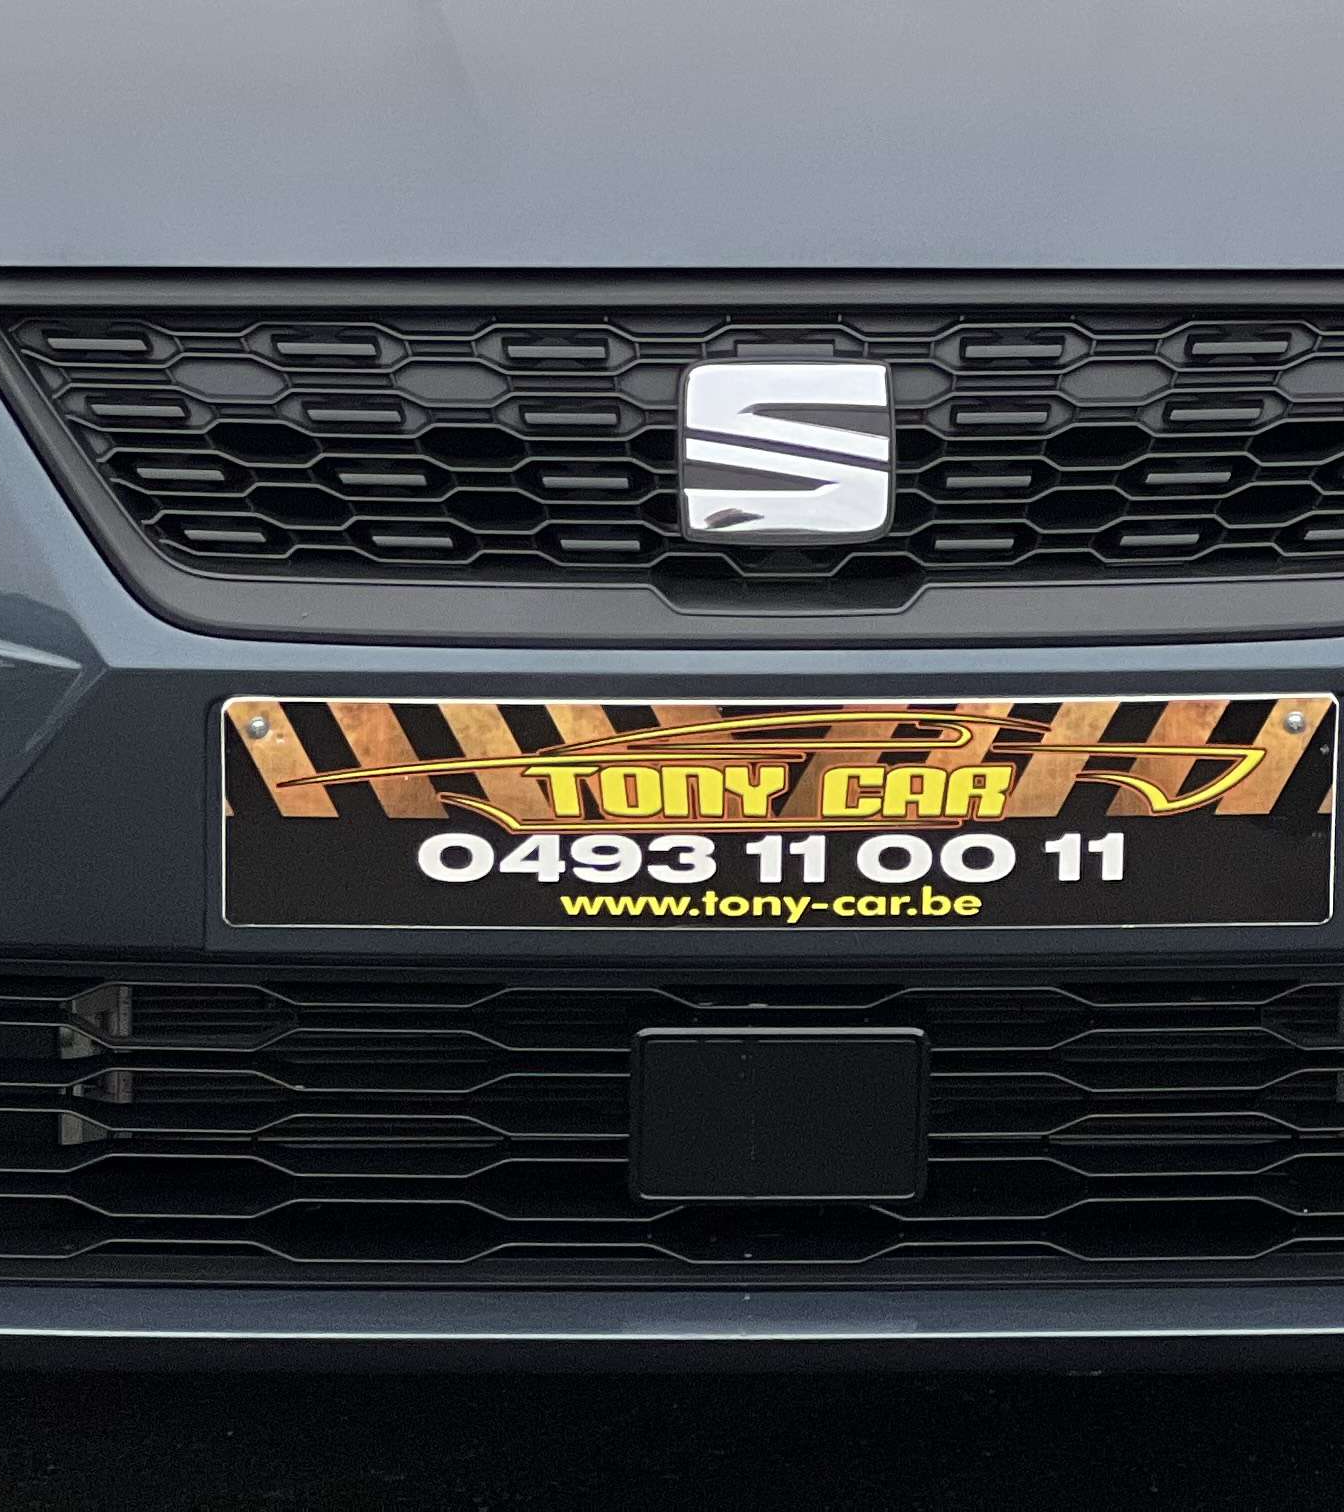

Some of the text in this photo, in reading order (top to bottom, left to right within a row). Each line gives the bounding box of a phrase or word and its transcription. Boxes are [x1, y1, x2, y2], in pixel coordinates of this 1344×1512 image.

[523, 765, 1013, 818] TONY CAR
[418, 832, 1125, 884] 0493 11 00 11
[560, 885, 983, 924] www.tony-car.be
